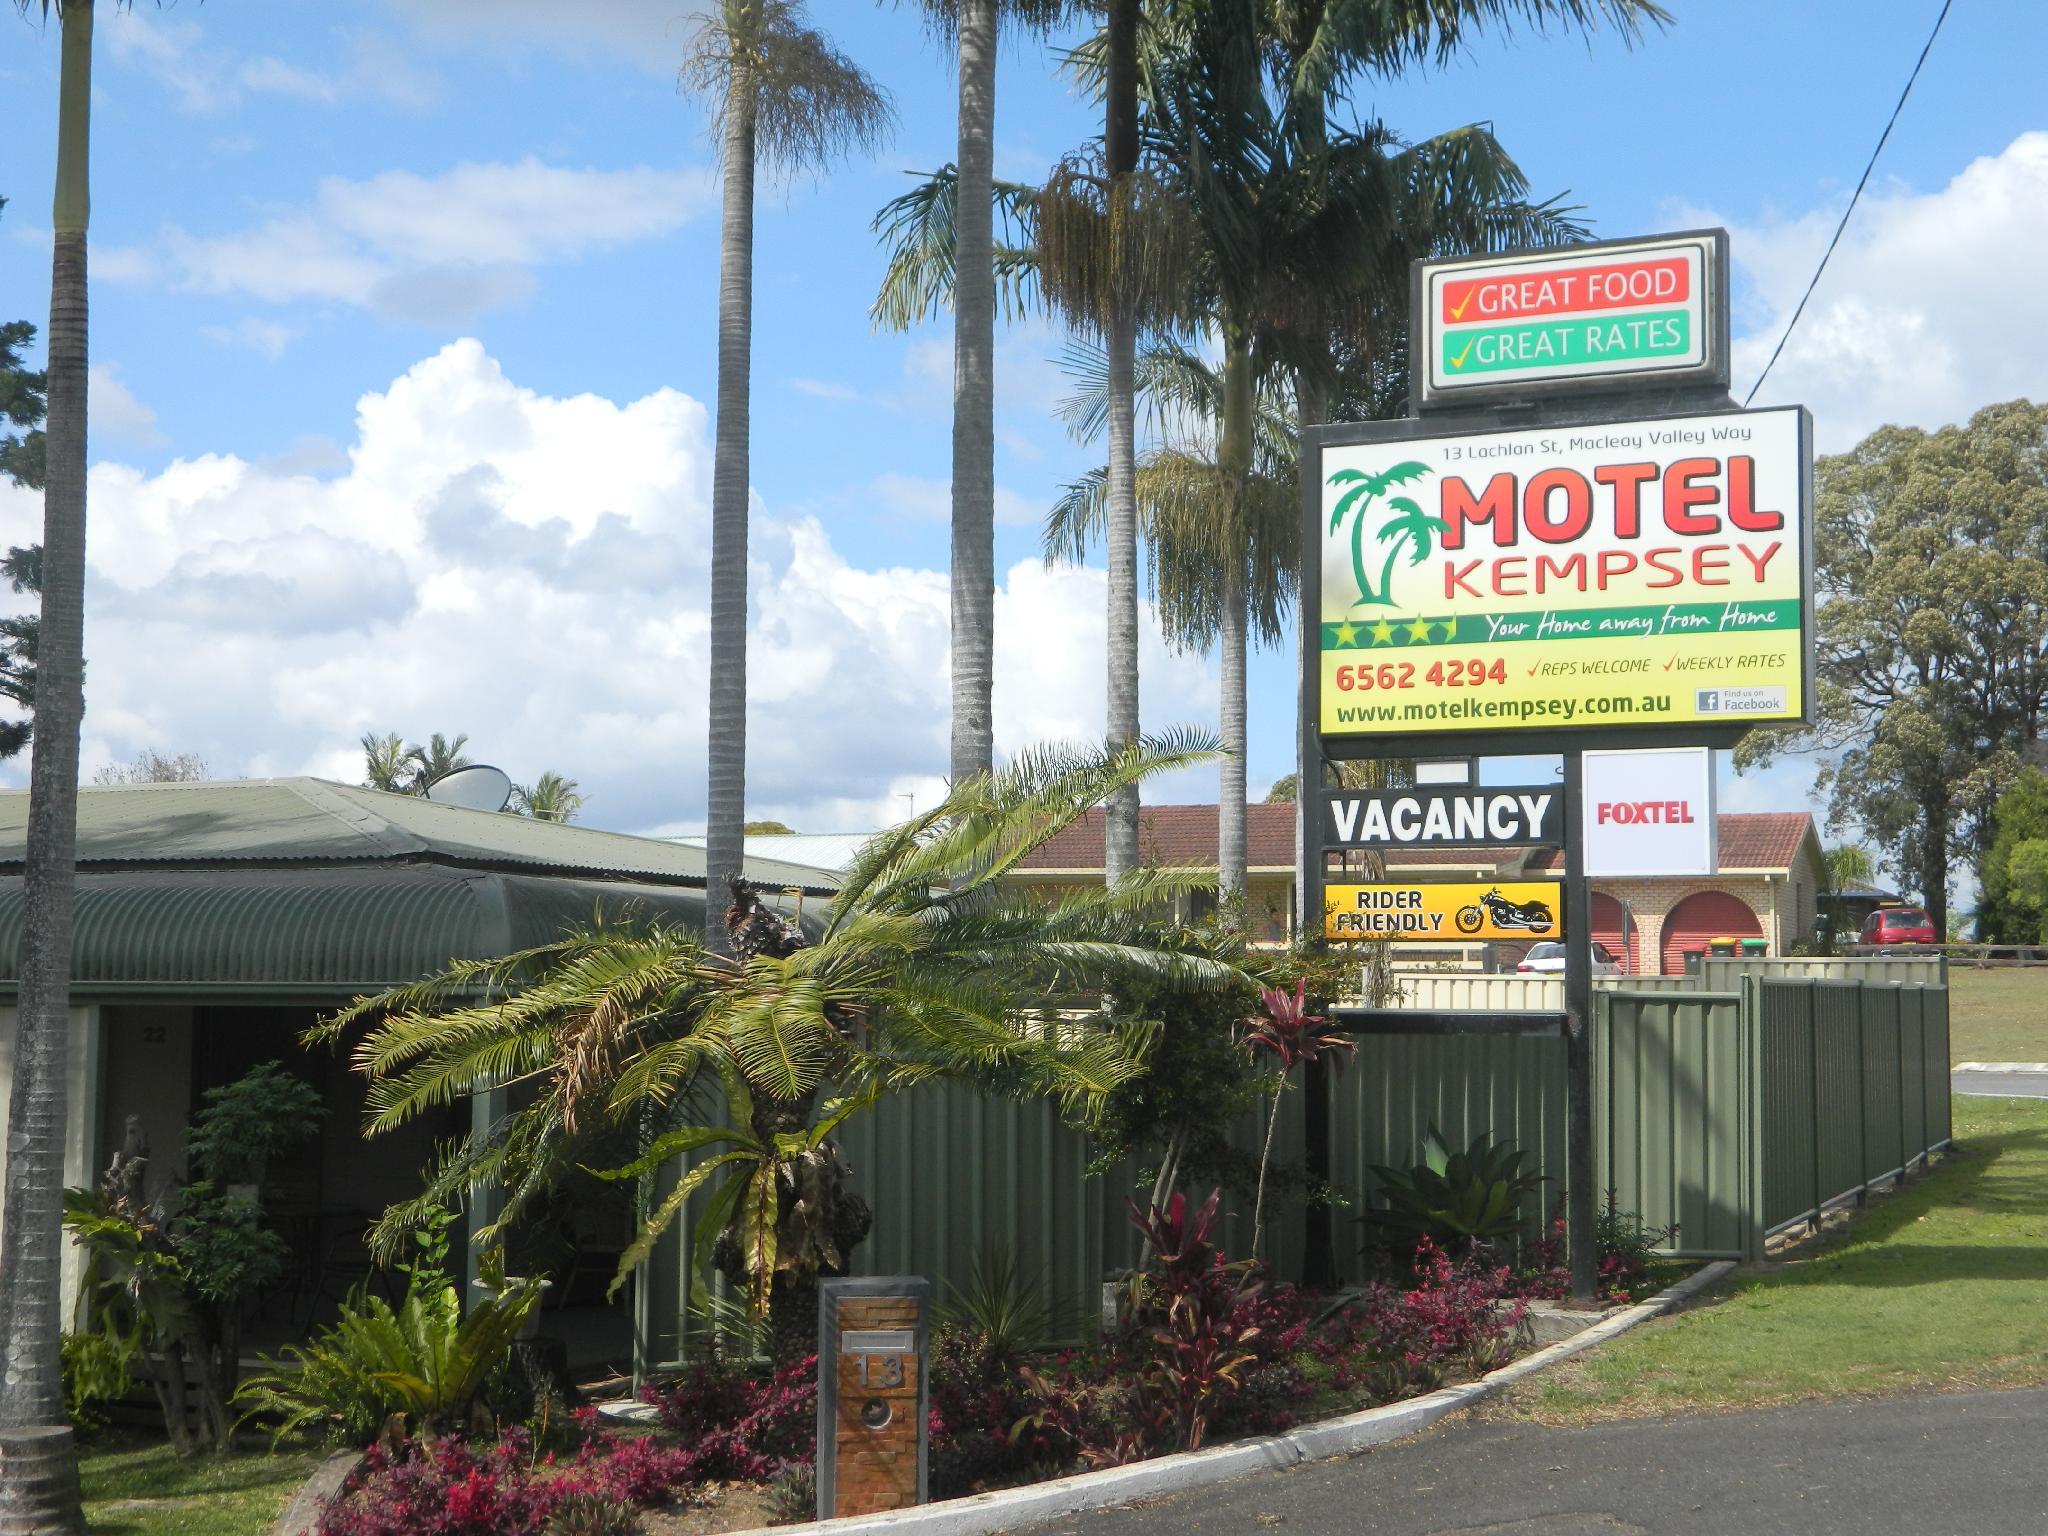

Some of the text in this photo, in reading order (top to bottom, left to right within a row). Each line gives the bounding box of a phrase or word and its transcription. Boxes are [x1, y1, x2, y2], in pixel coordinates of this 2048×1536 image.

[1477, 267, 1677, 313] GREAT FOOD
[1476, 316, 1682, 365] GREAT RATES
[1442, 425, 1752, 461] 13 Lachlan St, Macleay Valley Way
[1440, 455, 1785, 551] MOTEL
[1445, 541, 1783, 600] KEMPSEY
[1485, 600, 1778, 642] Your Home away from Home
[1336, 657, 1508, 692] 6562 4294
[1541, 657, 1653, 677] REPS WELCOME
[1676, 652, 1787, 672] WEEKLY RATES
[1337, 693, 1672, 723] www.motelkempsey.com.au
[1724, 690, 1764, 698] Find us on
[1724, 697, 1781, 711] Facebook
[1330, 794, 1552, 842] VACANCY
[1597, 800, 1695, 825] FOXTEL
[1357, 890, 1423, 910] RIDER
[1337, 912, 1444, 932] FRIENDLY
[855, 1354, 903, 1387] 13
